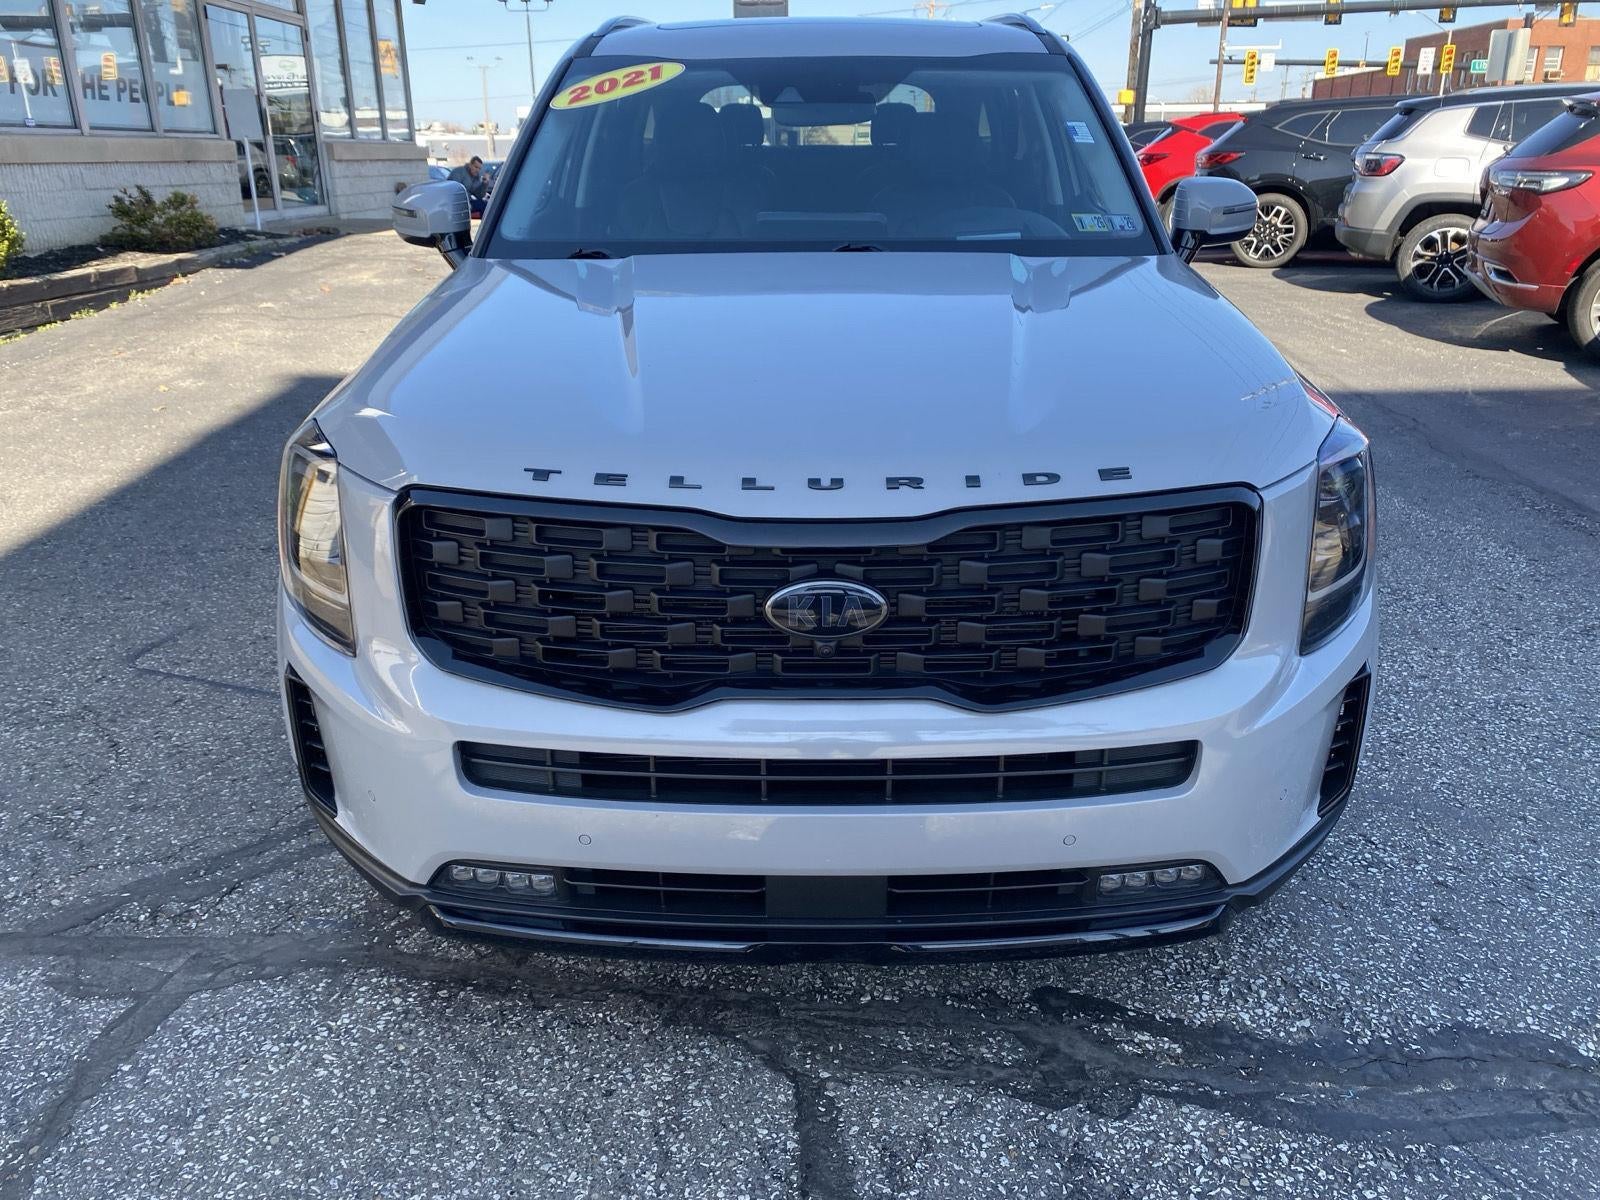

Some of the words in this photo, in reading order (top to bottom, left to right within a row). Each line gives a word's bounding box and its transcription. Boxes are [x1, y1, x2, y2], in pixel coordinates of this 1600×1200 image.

[80, 72, 110, 101] HE
[116, 77, 187, 107] PEPL
[567, 64, 663, 105] 2021
[524, 466, 1132, 491] TELLURIDE
[787, 595, 868, 628] KIA
